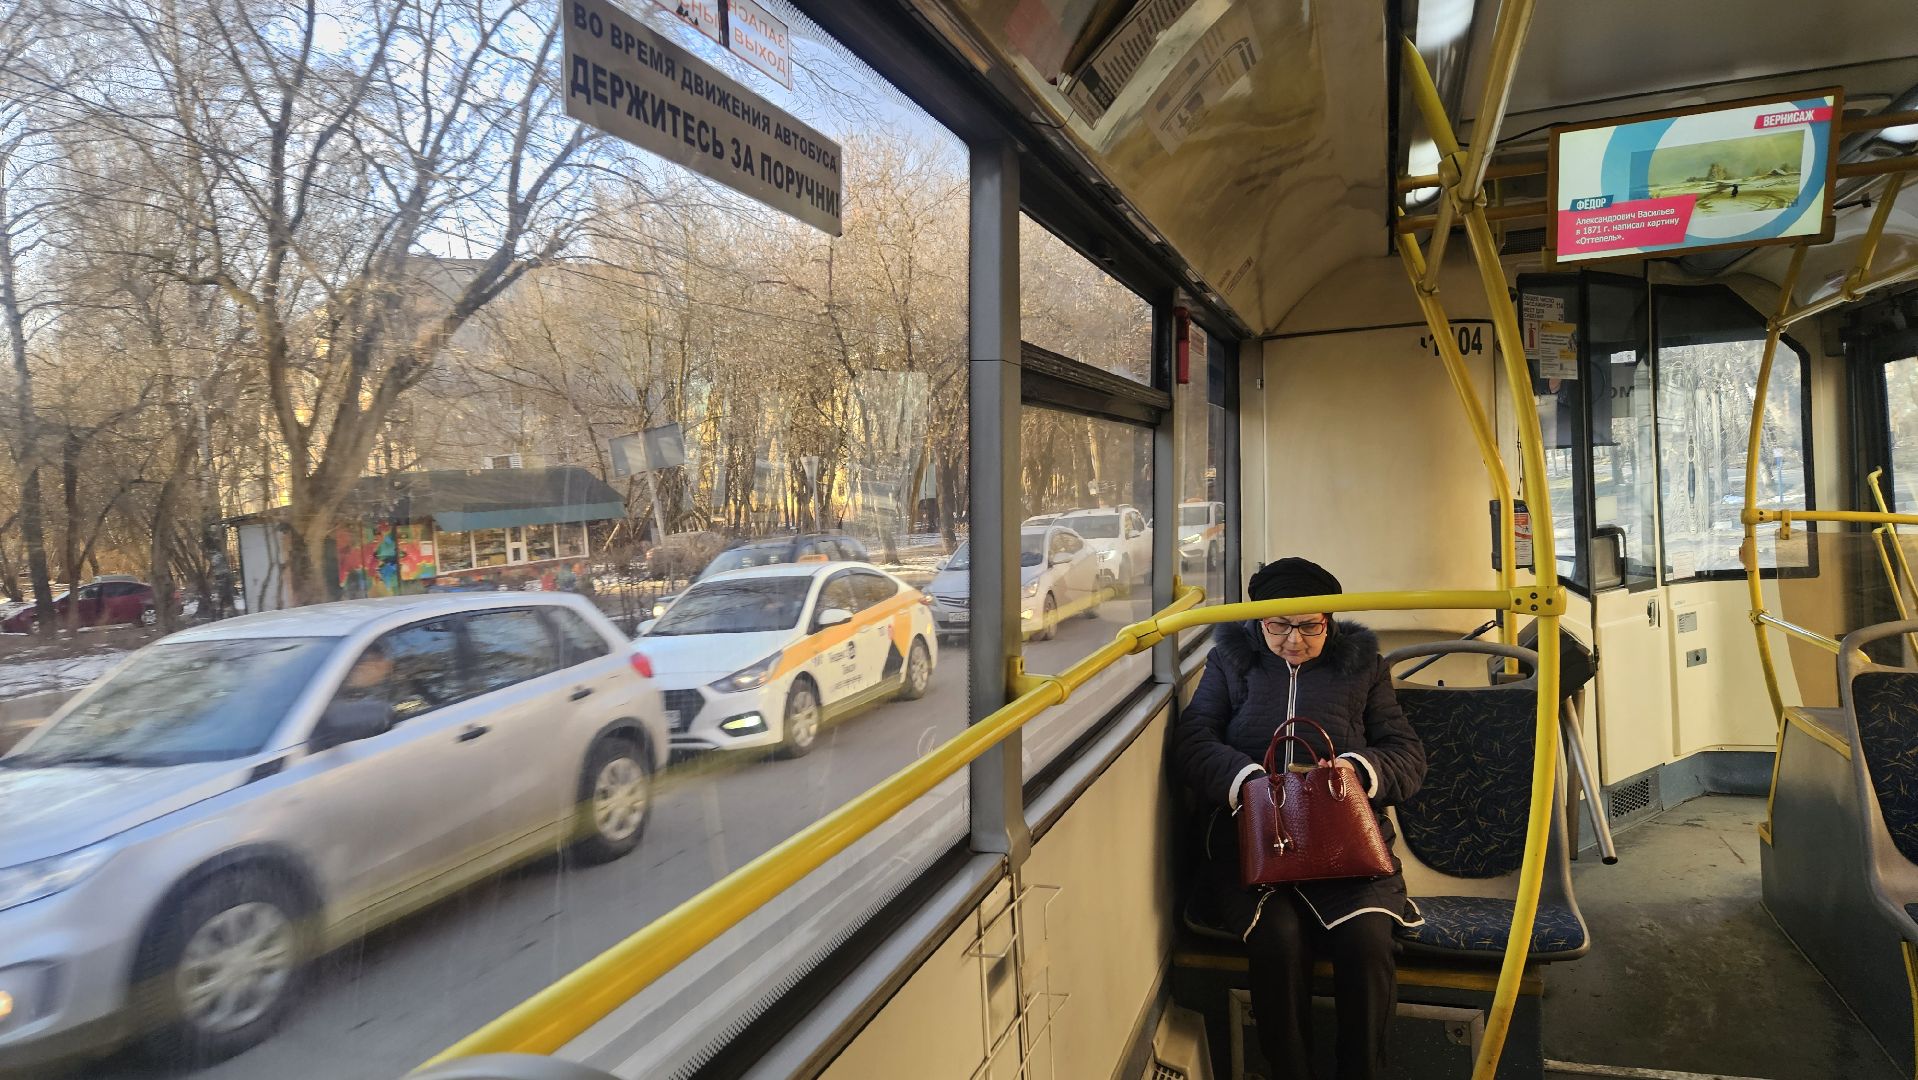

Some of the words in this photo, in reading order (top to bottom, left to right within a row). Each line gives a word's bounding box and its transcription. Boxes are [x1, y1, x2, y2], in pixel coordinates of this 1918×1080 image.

[734, 27, 785, 77] ВЫХОД
[573, 2, 603, 39] ВО
[611, 23, 675, 81] ВРЕМЯ
[681, 66, 770, 135] ДВИЖЕНИЯ
[774, 122, 837, 174] АВТОБУСА
[1763, 109, 1815, 127] ВЕРНИСАЖ
[571, 54, 724, 160] ДЕРЖИТЕСЬ
[731, 137, 755, 177] ЗА
[760, 151, 840, 218] ПОРУЧНИ!
[1576, 213, 1636, 226] Александрович
[1637, 208, 1675, 218] Васильев
[1583, 225, 1601, 235] 1871
[1612, 221, 1645, 232] написал
[1647, 216, 1680, 228] картину
[1575, 234, 1625, 246] «Оттепель».
